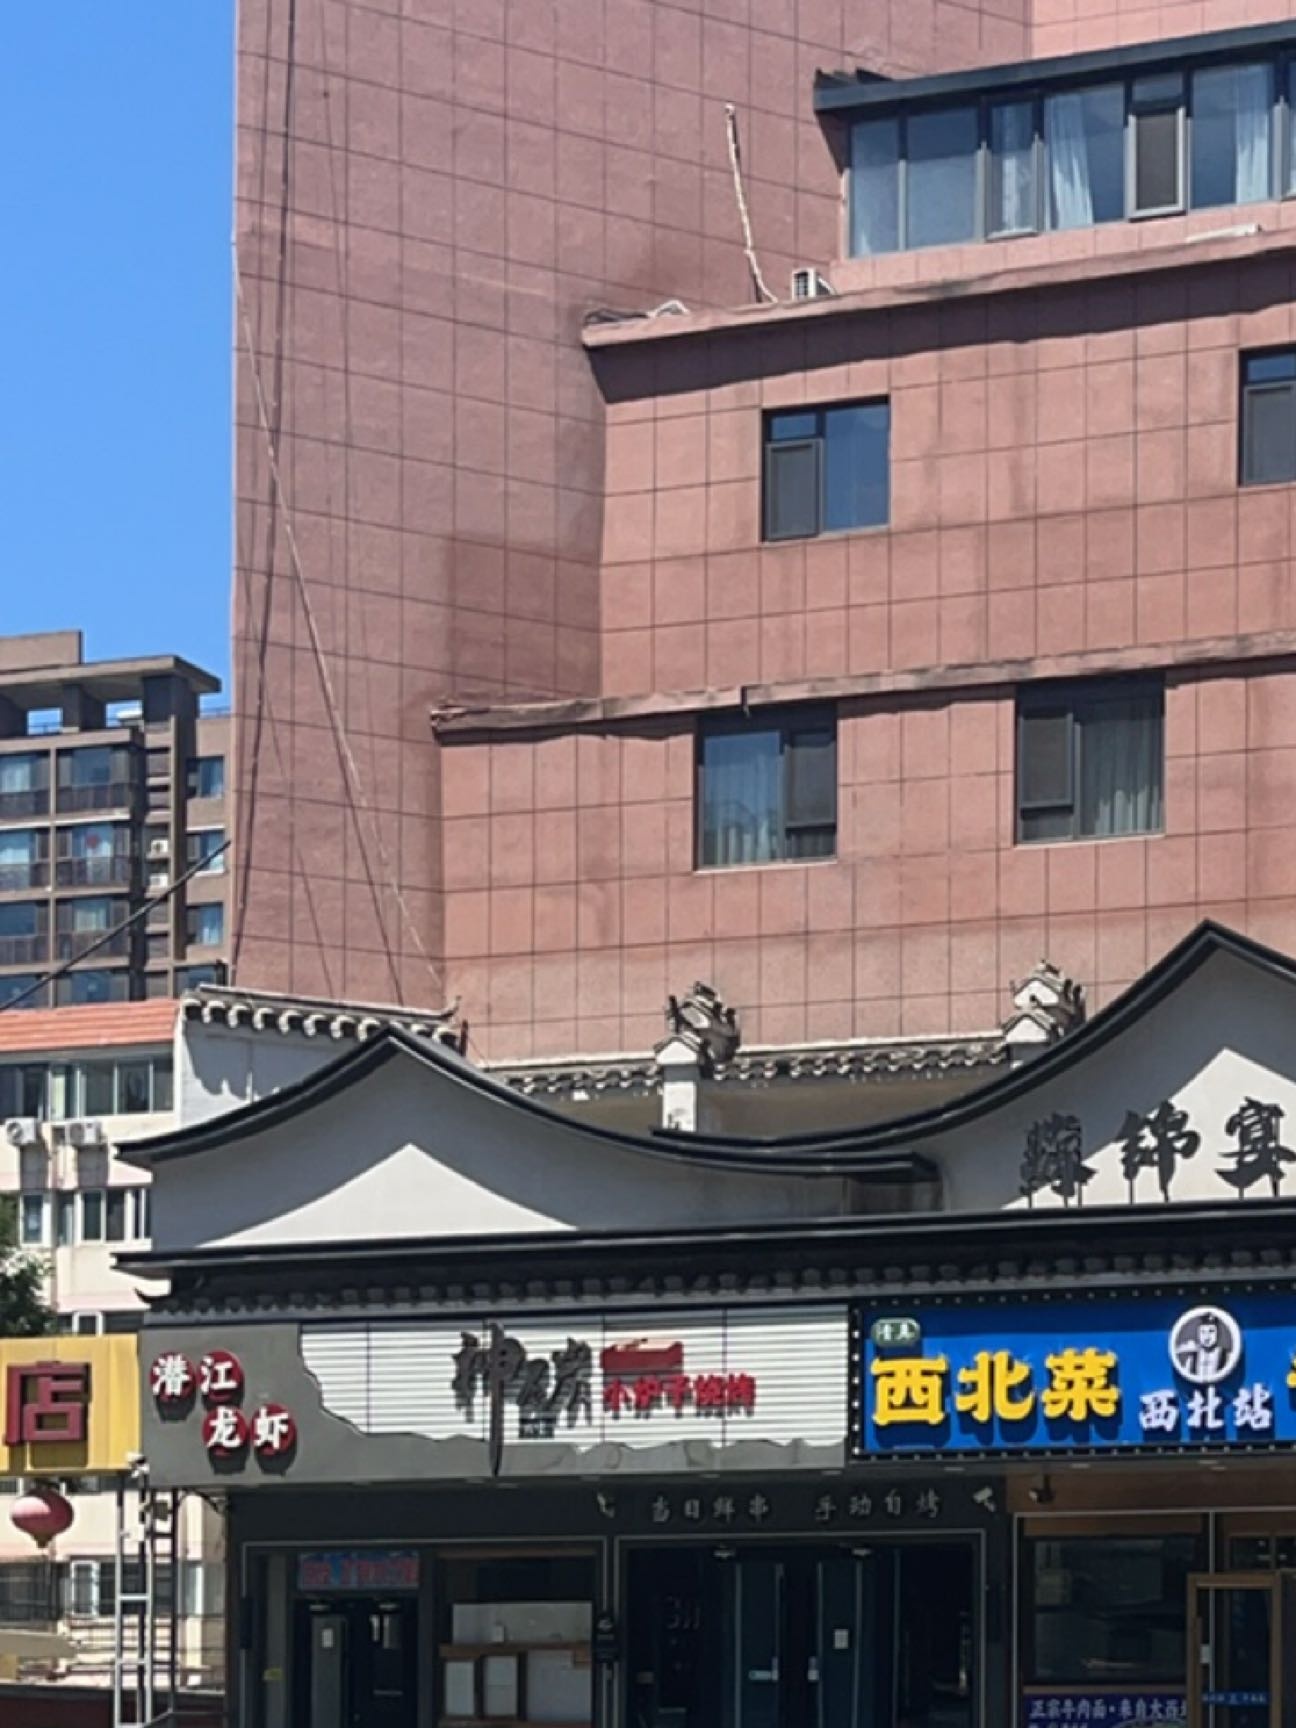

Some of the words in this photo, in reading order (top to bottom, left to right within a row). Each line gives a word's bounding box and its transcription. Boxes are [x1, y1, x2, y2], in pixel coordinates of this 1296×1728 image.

[152, 1357, 238, 1396] 潜江
[871, 1347, 1119, 1427] 西北菜
[5, 1361, 90, 1445] 店
[1139, 1384, 1273, 1431] 西北站
[207, 1406, 289, 1448] 龙虾
